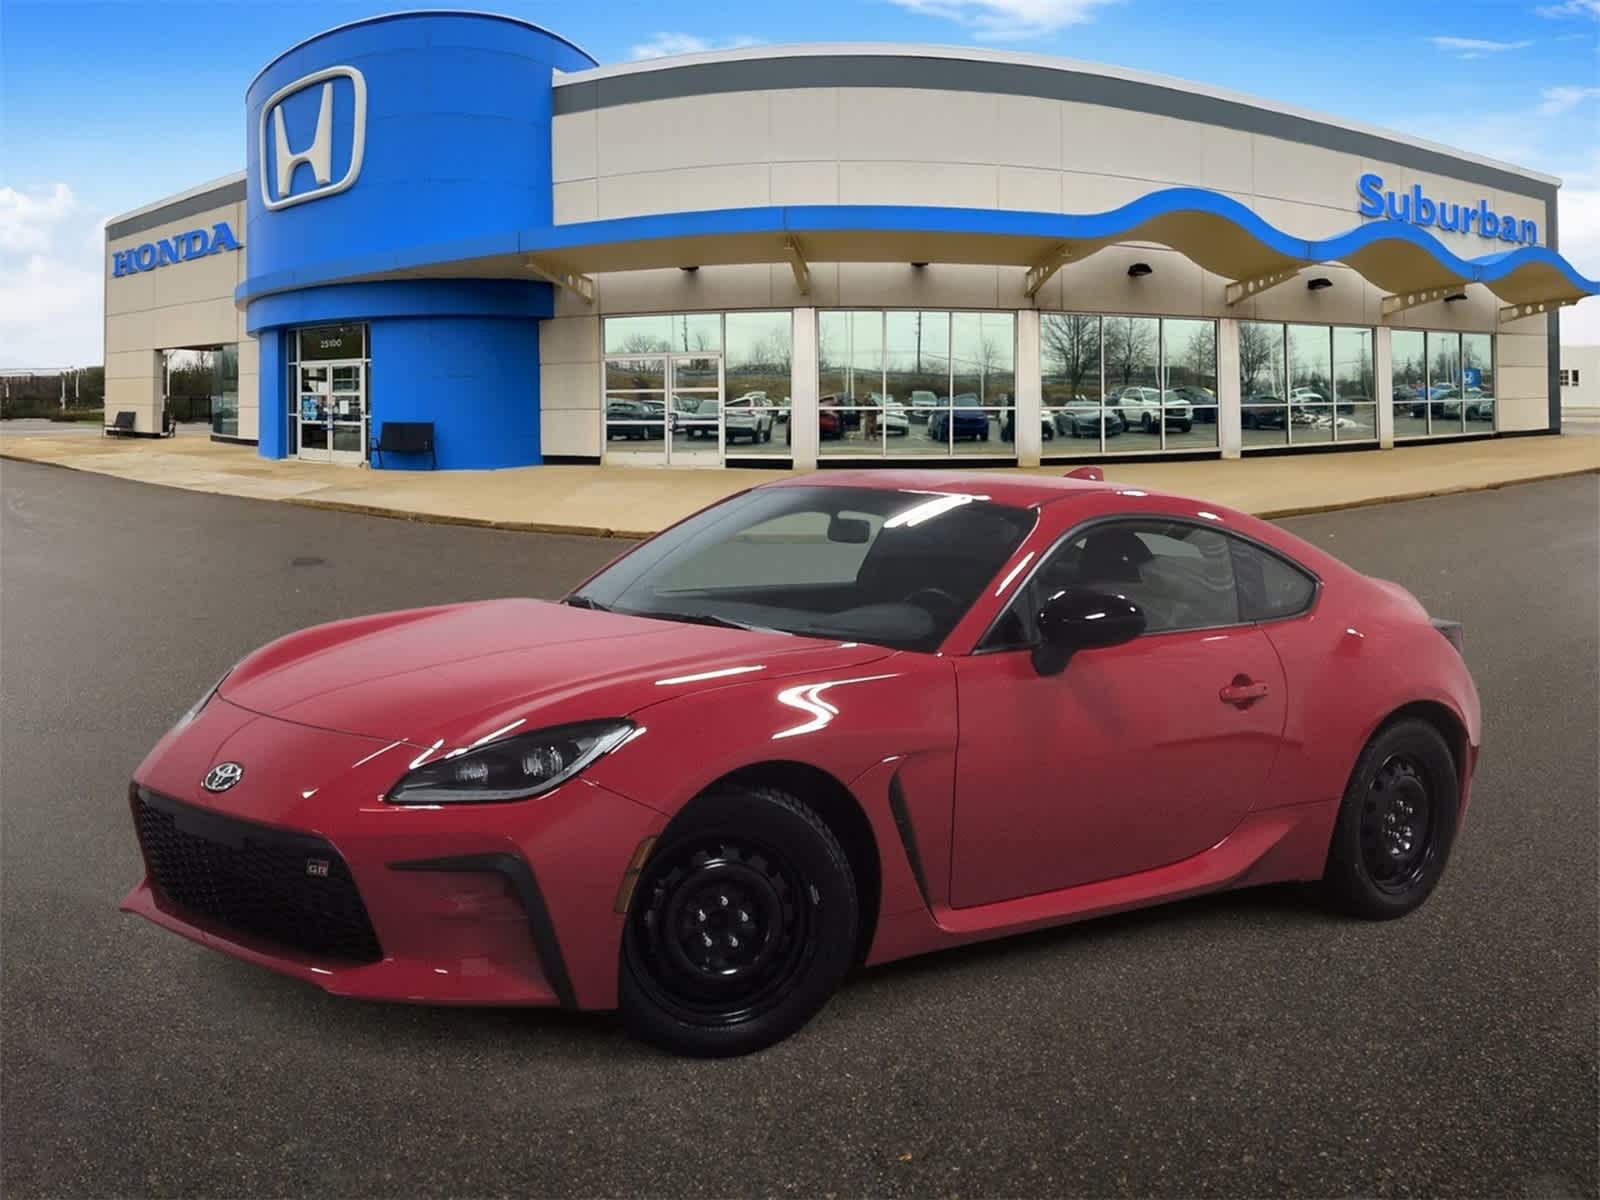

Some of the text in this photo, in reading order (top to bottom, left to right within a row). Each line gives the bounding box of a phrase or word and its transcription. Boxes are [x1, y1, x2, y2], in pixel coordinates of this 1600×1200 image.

[1358, 173, 1537, 246] Suburban
[112, 222, 241, 277] HONDA
[308, 864, 328, 877] GR
